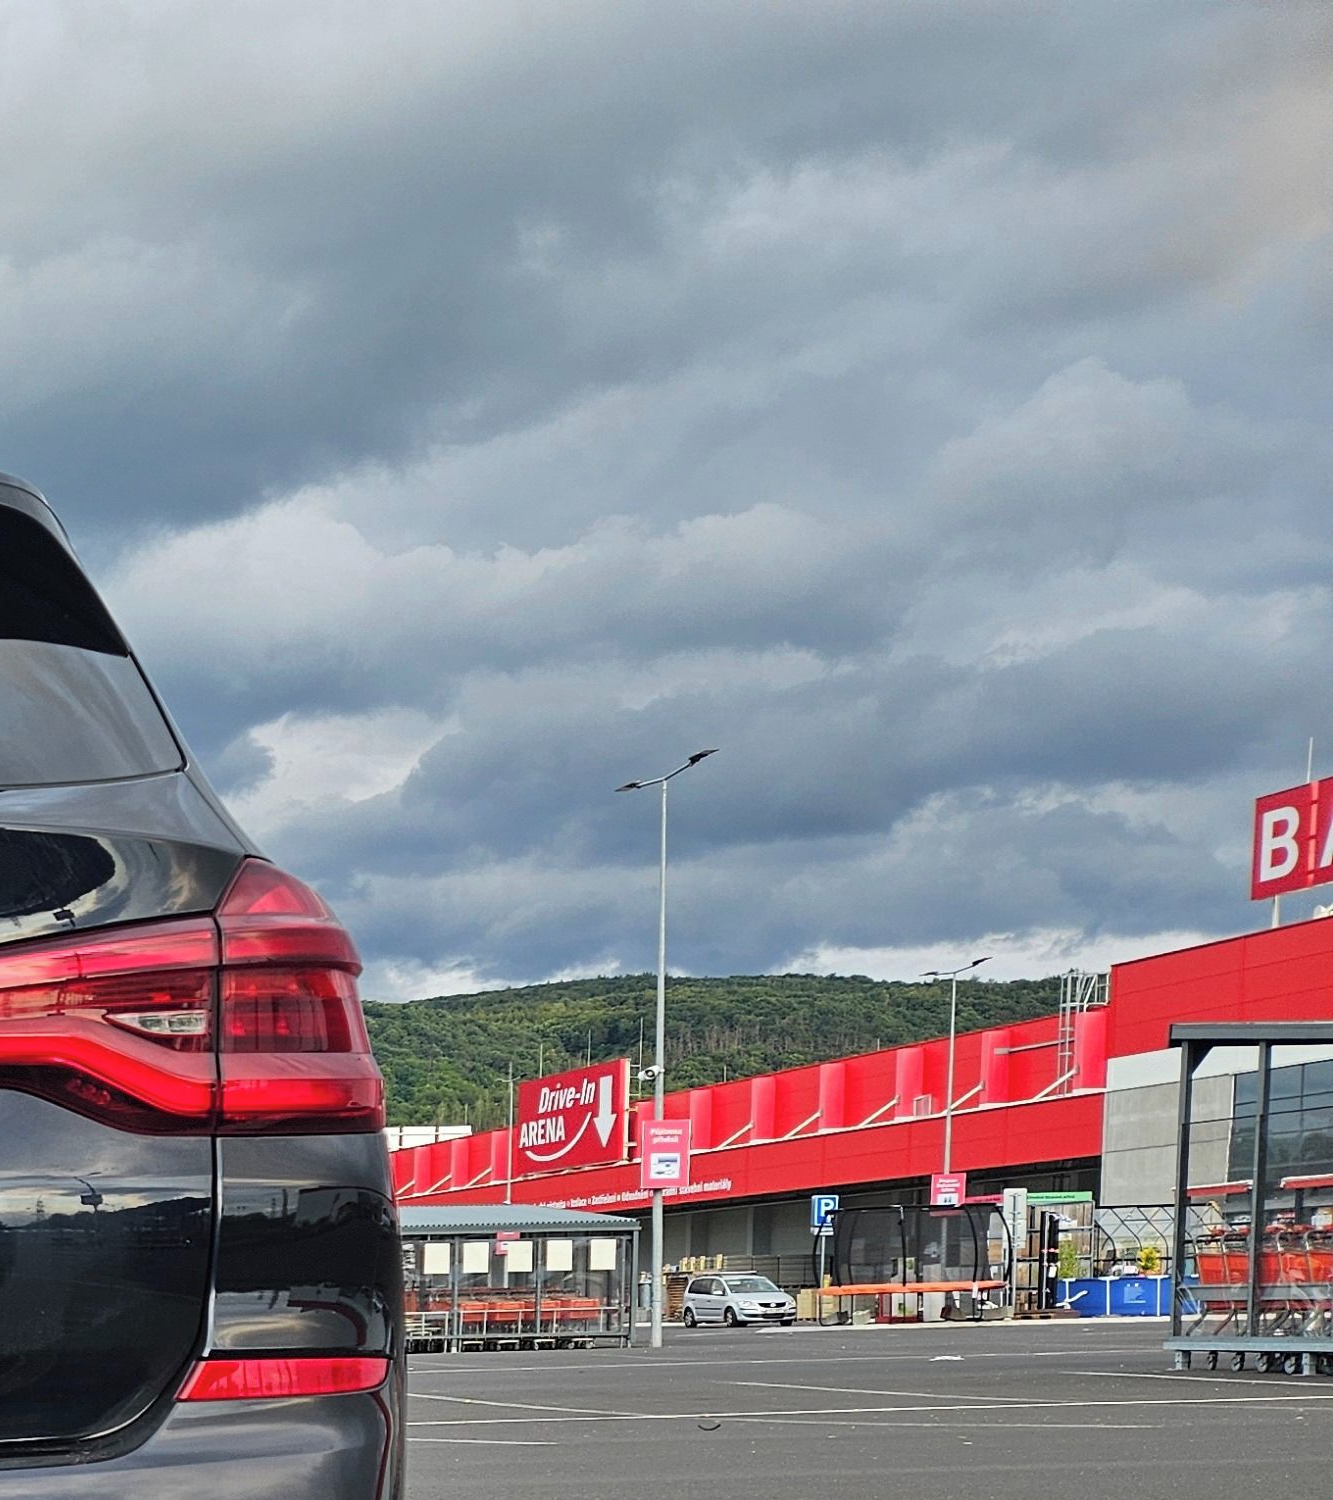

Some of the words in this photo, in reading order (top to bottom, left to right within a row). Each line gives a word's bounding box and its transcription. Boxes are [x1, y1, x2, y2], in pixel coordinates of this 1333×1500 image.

[537, 1078, 596, 1114] Drive-In
[518, 1115, 566, 1149] ARENA
[820, 1198, 835, 1217] P
